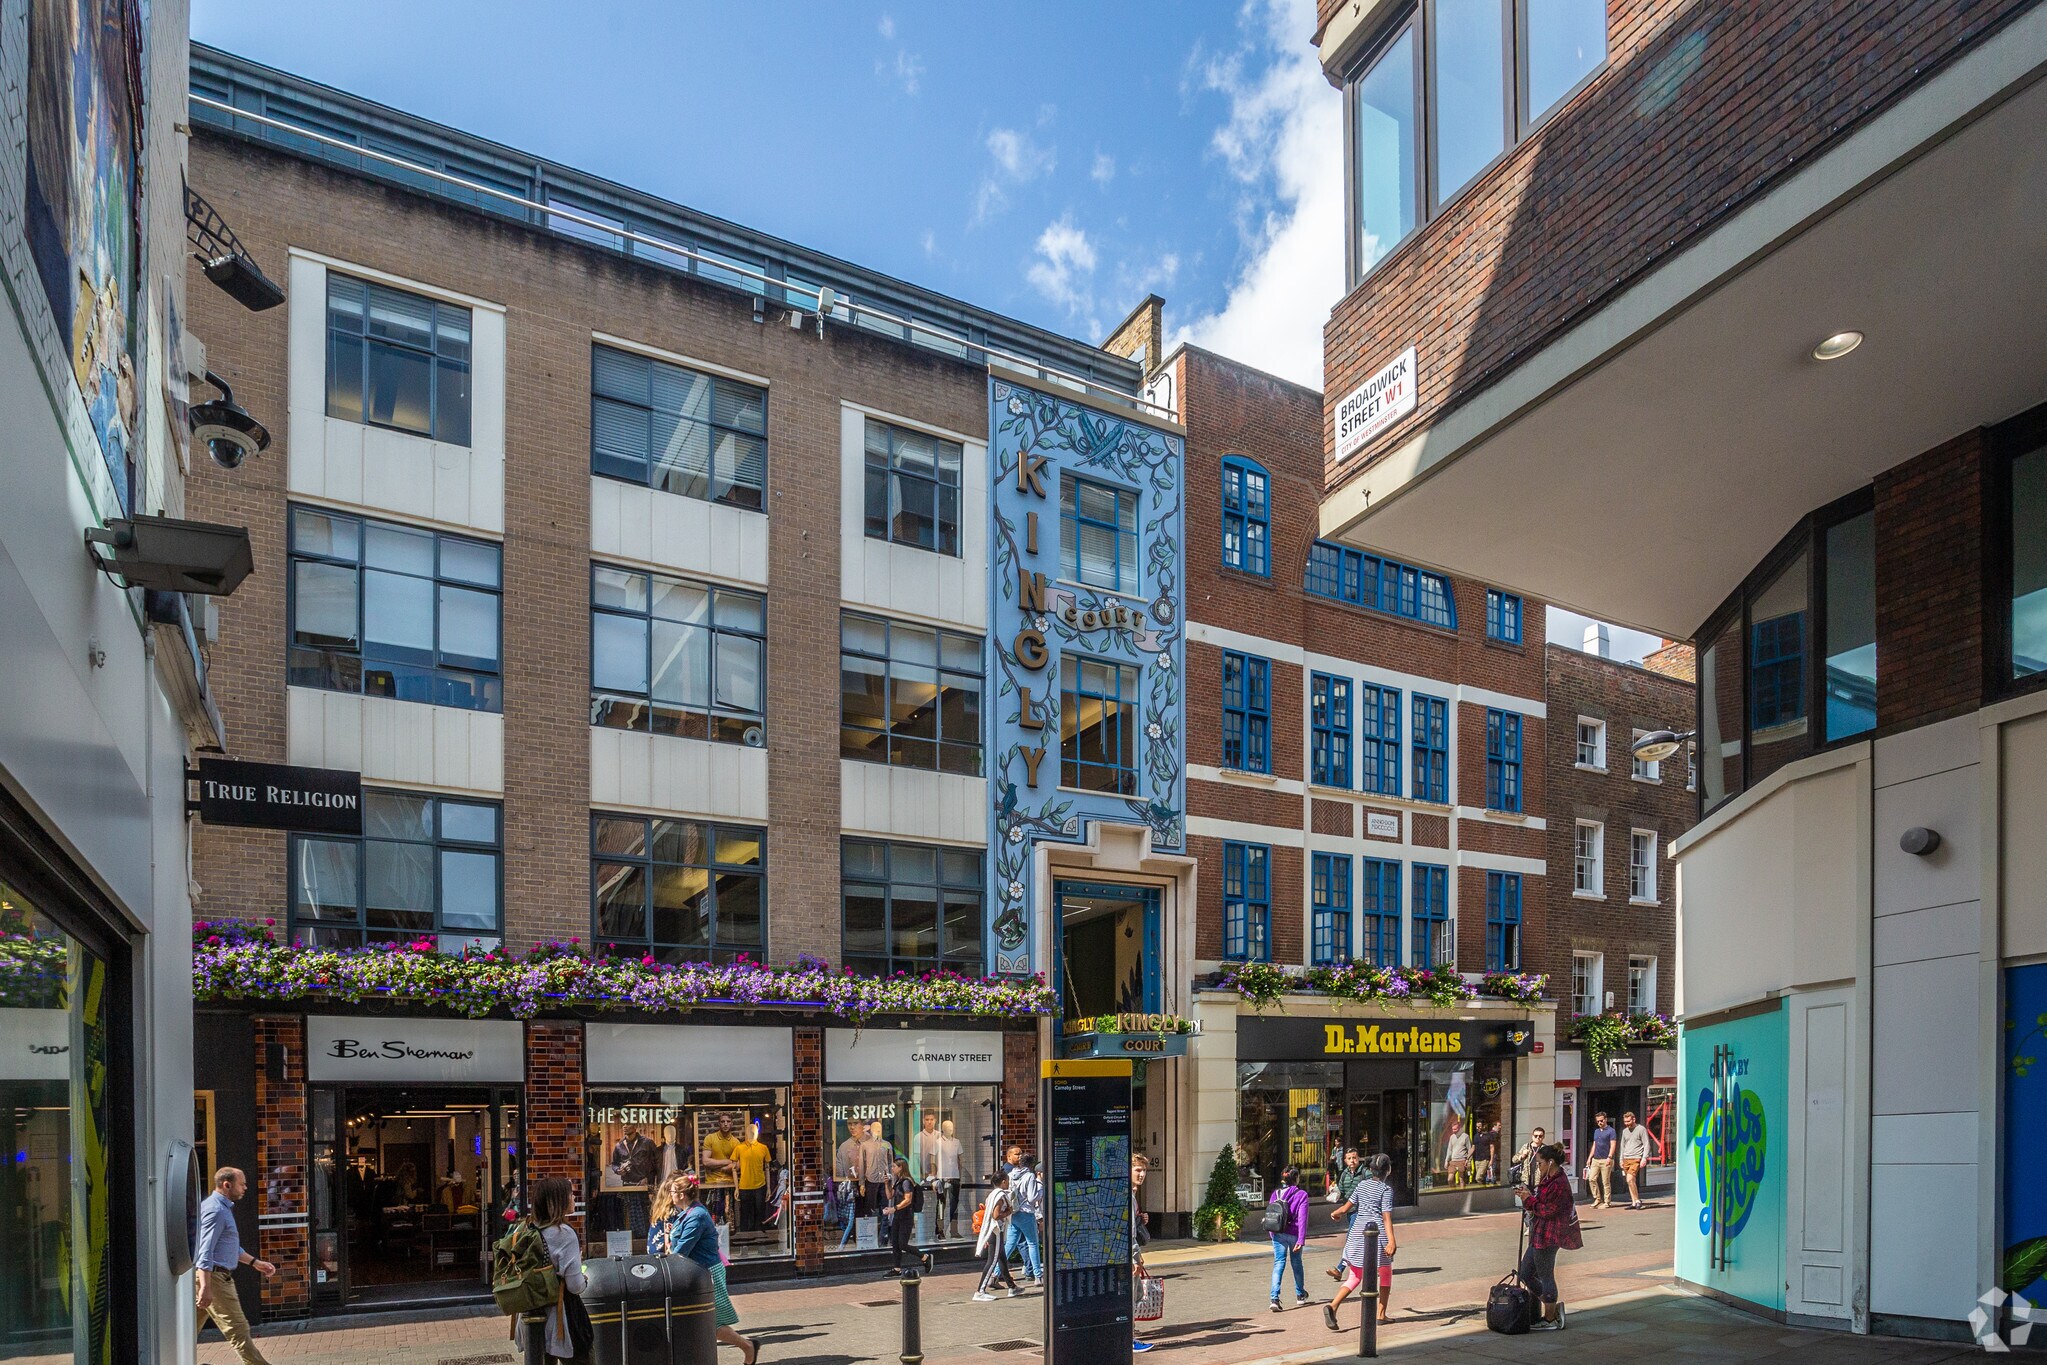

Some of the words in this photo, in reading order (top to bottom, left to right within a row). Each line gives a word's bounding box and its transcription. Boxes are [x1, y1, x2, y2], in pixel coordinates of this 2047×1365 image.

[1341, 358, 1407, 421] BROADWICK
[1341, 397, 1381, 438] STREET
[1385, 381, 1402, 405] W1
[1341, 443, 1352, 455] CITY
[1353, 435, 1360, 445] OF
[1360, 408, 1398, 441] WESTMINSTER
[1013, 450, 1050, 790] KINGLY
[1065, 606, 1143, 629] COURT
[205, 780, 257, 802] TRUE
[266, 785, 357, 810] RELIGION
[1063, 1016, 1095, 1035] KINGLY
[1117, 1012, 1181, 1032] KINGLY
[327, 1039, 380, 1058] Ben
[1124, 1039, 1167, 1051] COURT
[911, 1053, 957, 1063] CARNABY
[958, 1053, 993, 1062] STREET
[1709, 1058, 1750, 1079] CNABY
[588, 1107, 615, 1124] THE
[1149, 1157, 1160, 1168] 49
